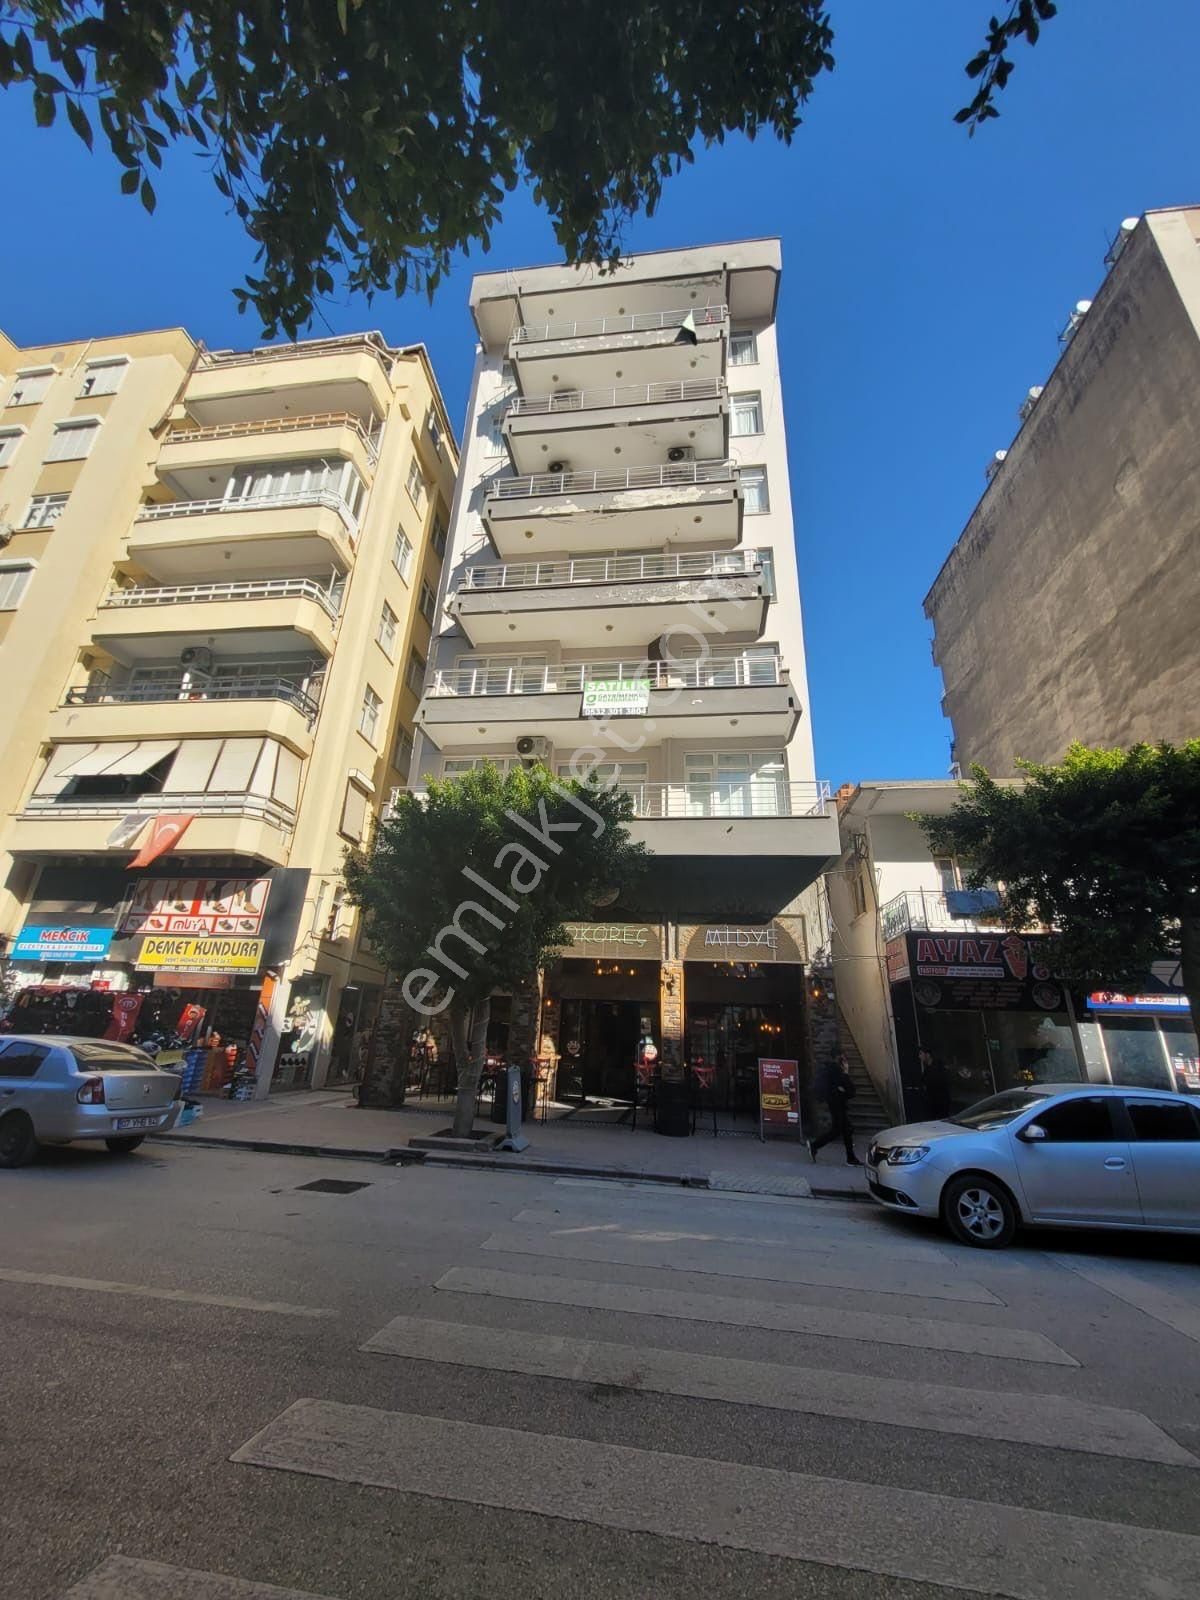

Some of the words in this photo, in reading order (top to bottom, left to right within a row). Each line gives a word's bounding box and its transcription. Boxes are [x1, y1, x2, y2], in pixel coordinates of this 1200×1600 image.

[587, 680, 648, 691] SATILIK
[565, 925, 650, 947] OKOREÇ
[704, 926, 778, 949] MİDYE
[145, 940, 191, 955] DEMET
[193, 941, 259, 957] KUNDURA
[917, 939, 1002, 962] AYAZ
